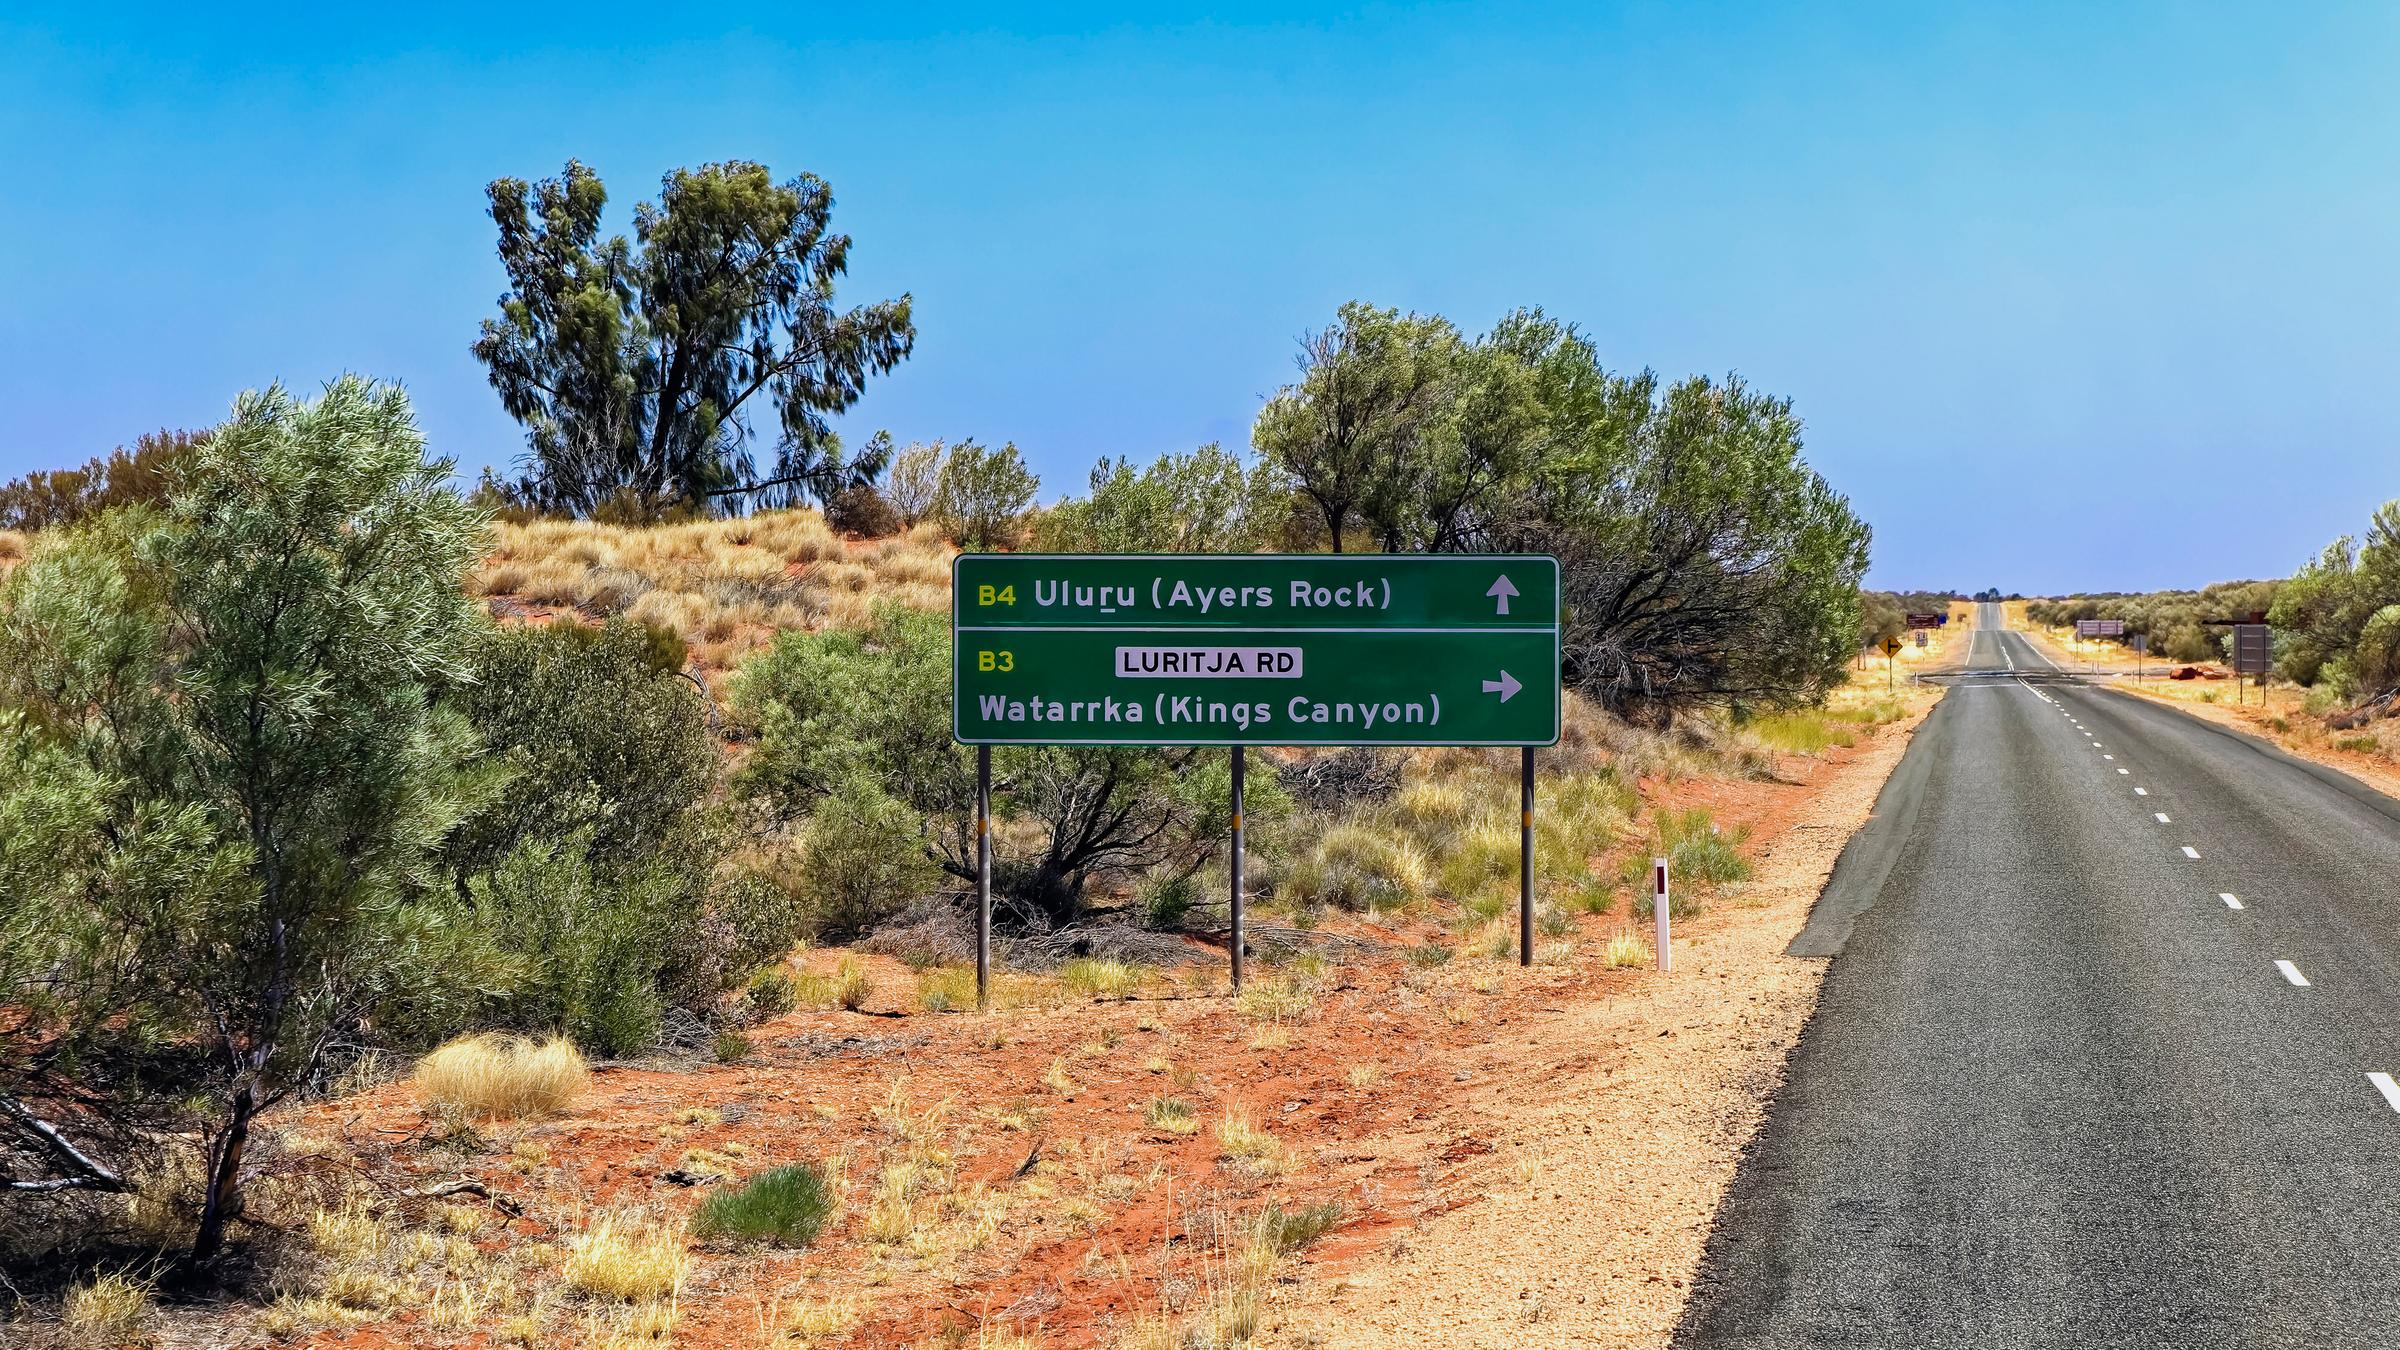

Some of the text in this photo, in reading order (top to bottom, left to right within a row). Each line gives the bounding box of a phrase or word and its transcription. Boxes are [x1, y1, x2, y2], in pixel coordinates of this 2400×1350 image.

[978, 585, 1017, 606] B4
[1152, 577, 1273, 614] (Ayers
[1290, 578, 1391, 610] Rock)
[978, 650, 1014, 672] B3
[1123, 651, 1295, 673] LURITJA RD
[978, 693, 1440, 732] Watarrka (Kings Canyon)
